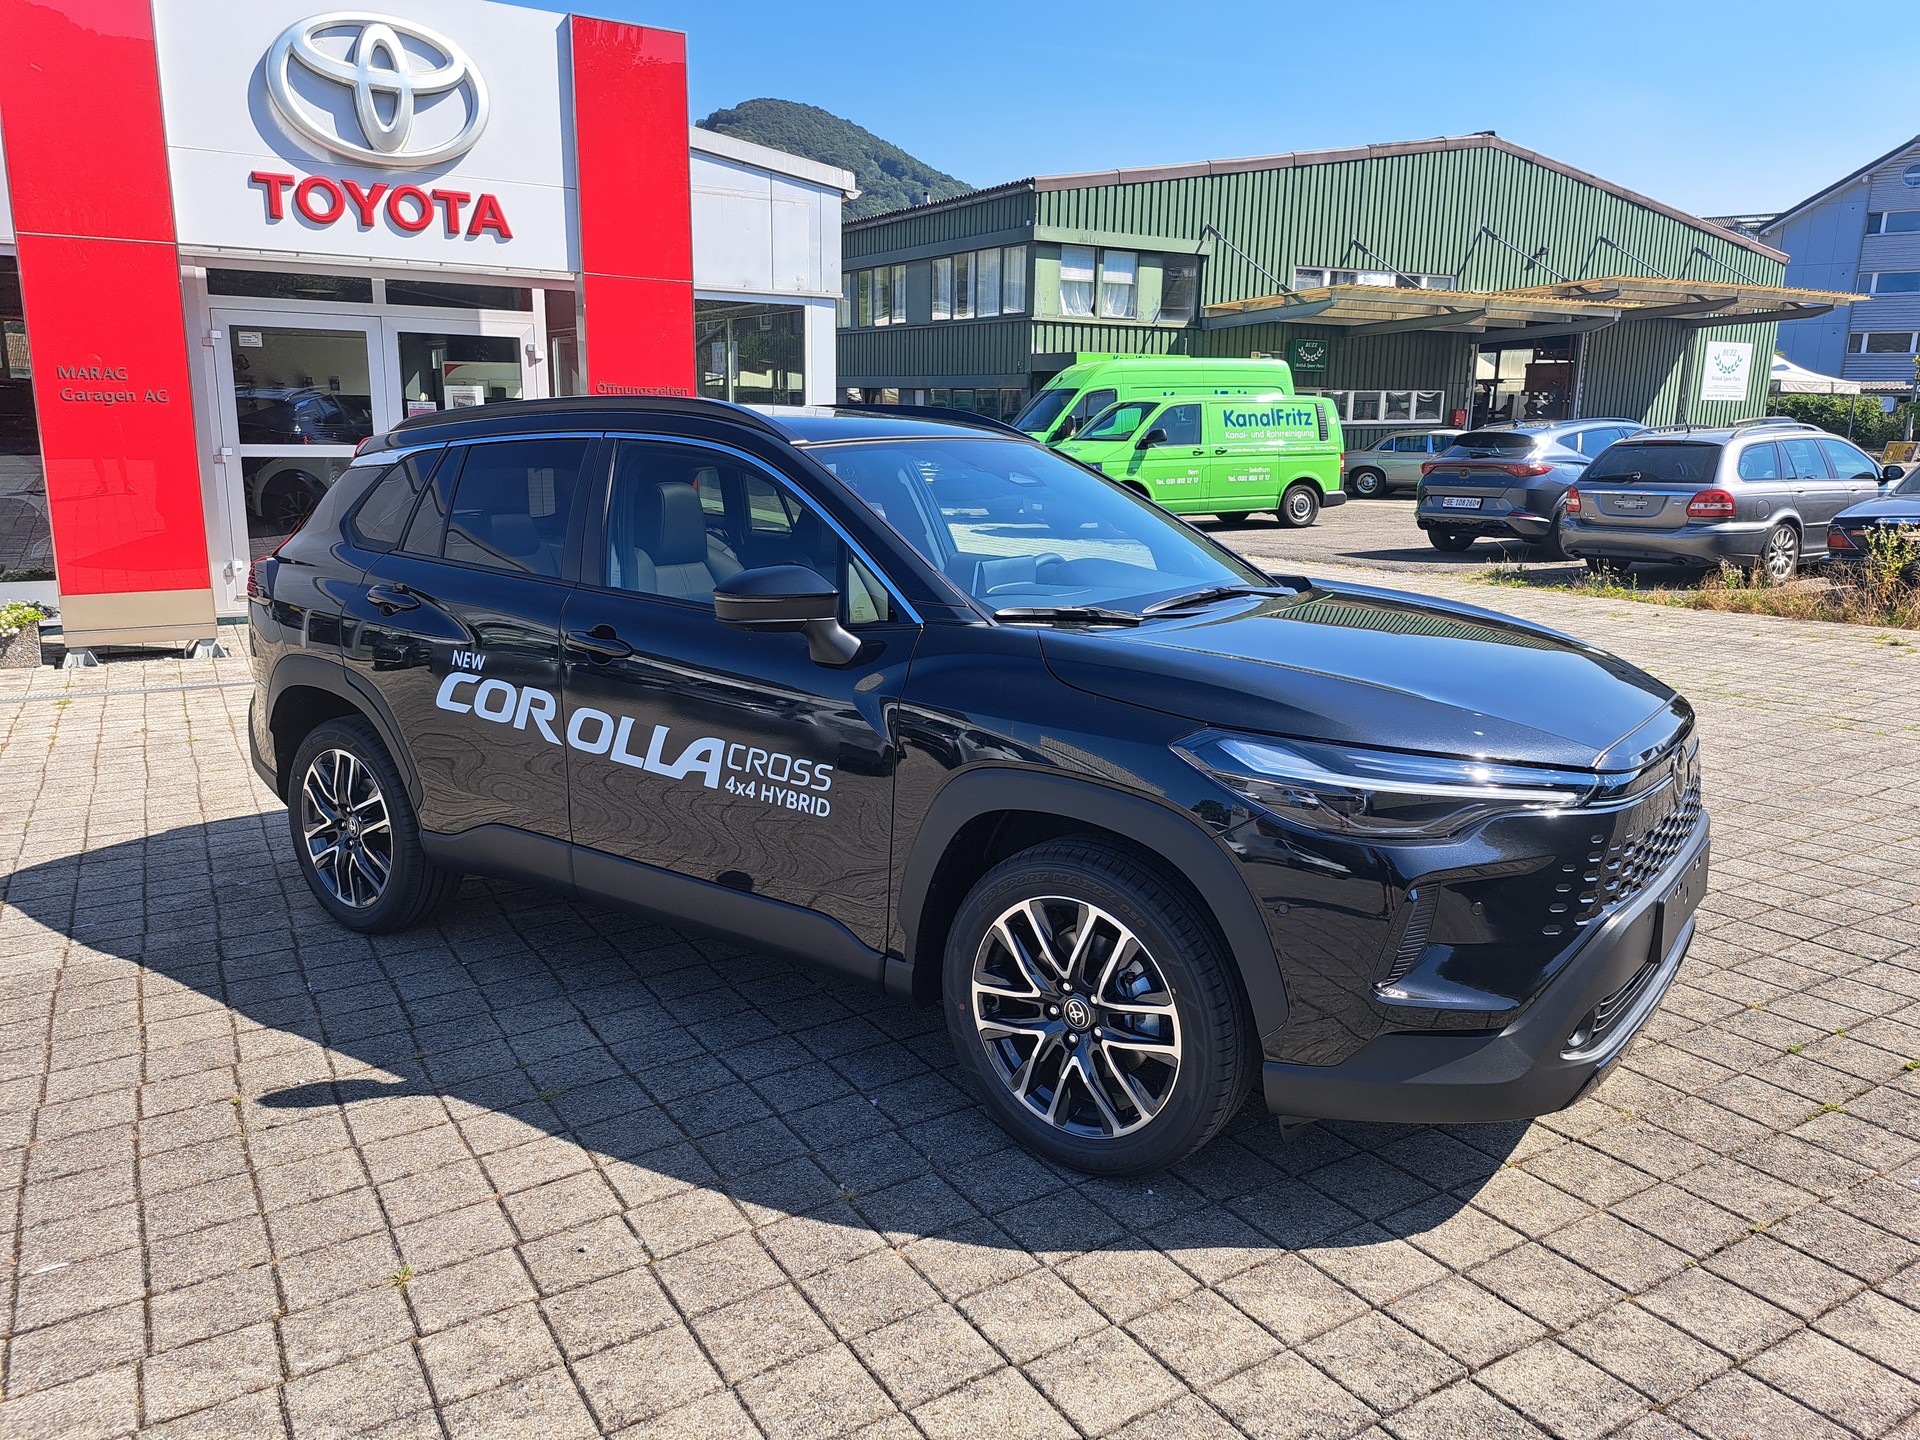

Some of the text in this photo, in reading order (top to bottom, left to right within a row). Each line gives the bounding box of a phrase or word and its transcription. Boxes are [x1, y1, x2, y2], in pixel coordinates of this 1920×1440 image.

[250, 170, 514, 239] TOYOTA
[56, 365, 129, 381] MARAG
[60, 387, 170, 406] Garagen AG
[1223, 406, 1313, 428] KanalFritz
[1225, 429, 1315, 440] Kanal- und Rohrreinigung
[451, 649, 487, 671] NEW
[434, 671, 834, 792] COROLLA CROSS
[724, 775, 832, 818] 4x4 HYBRID
